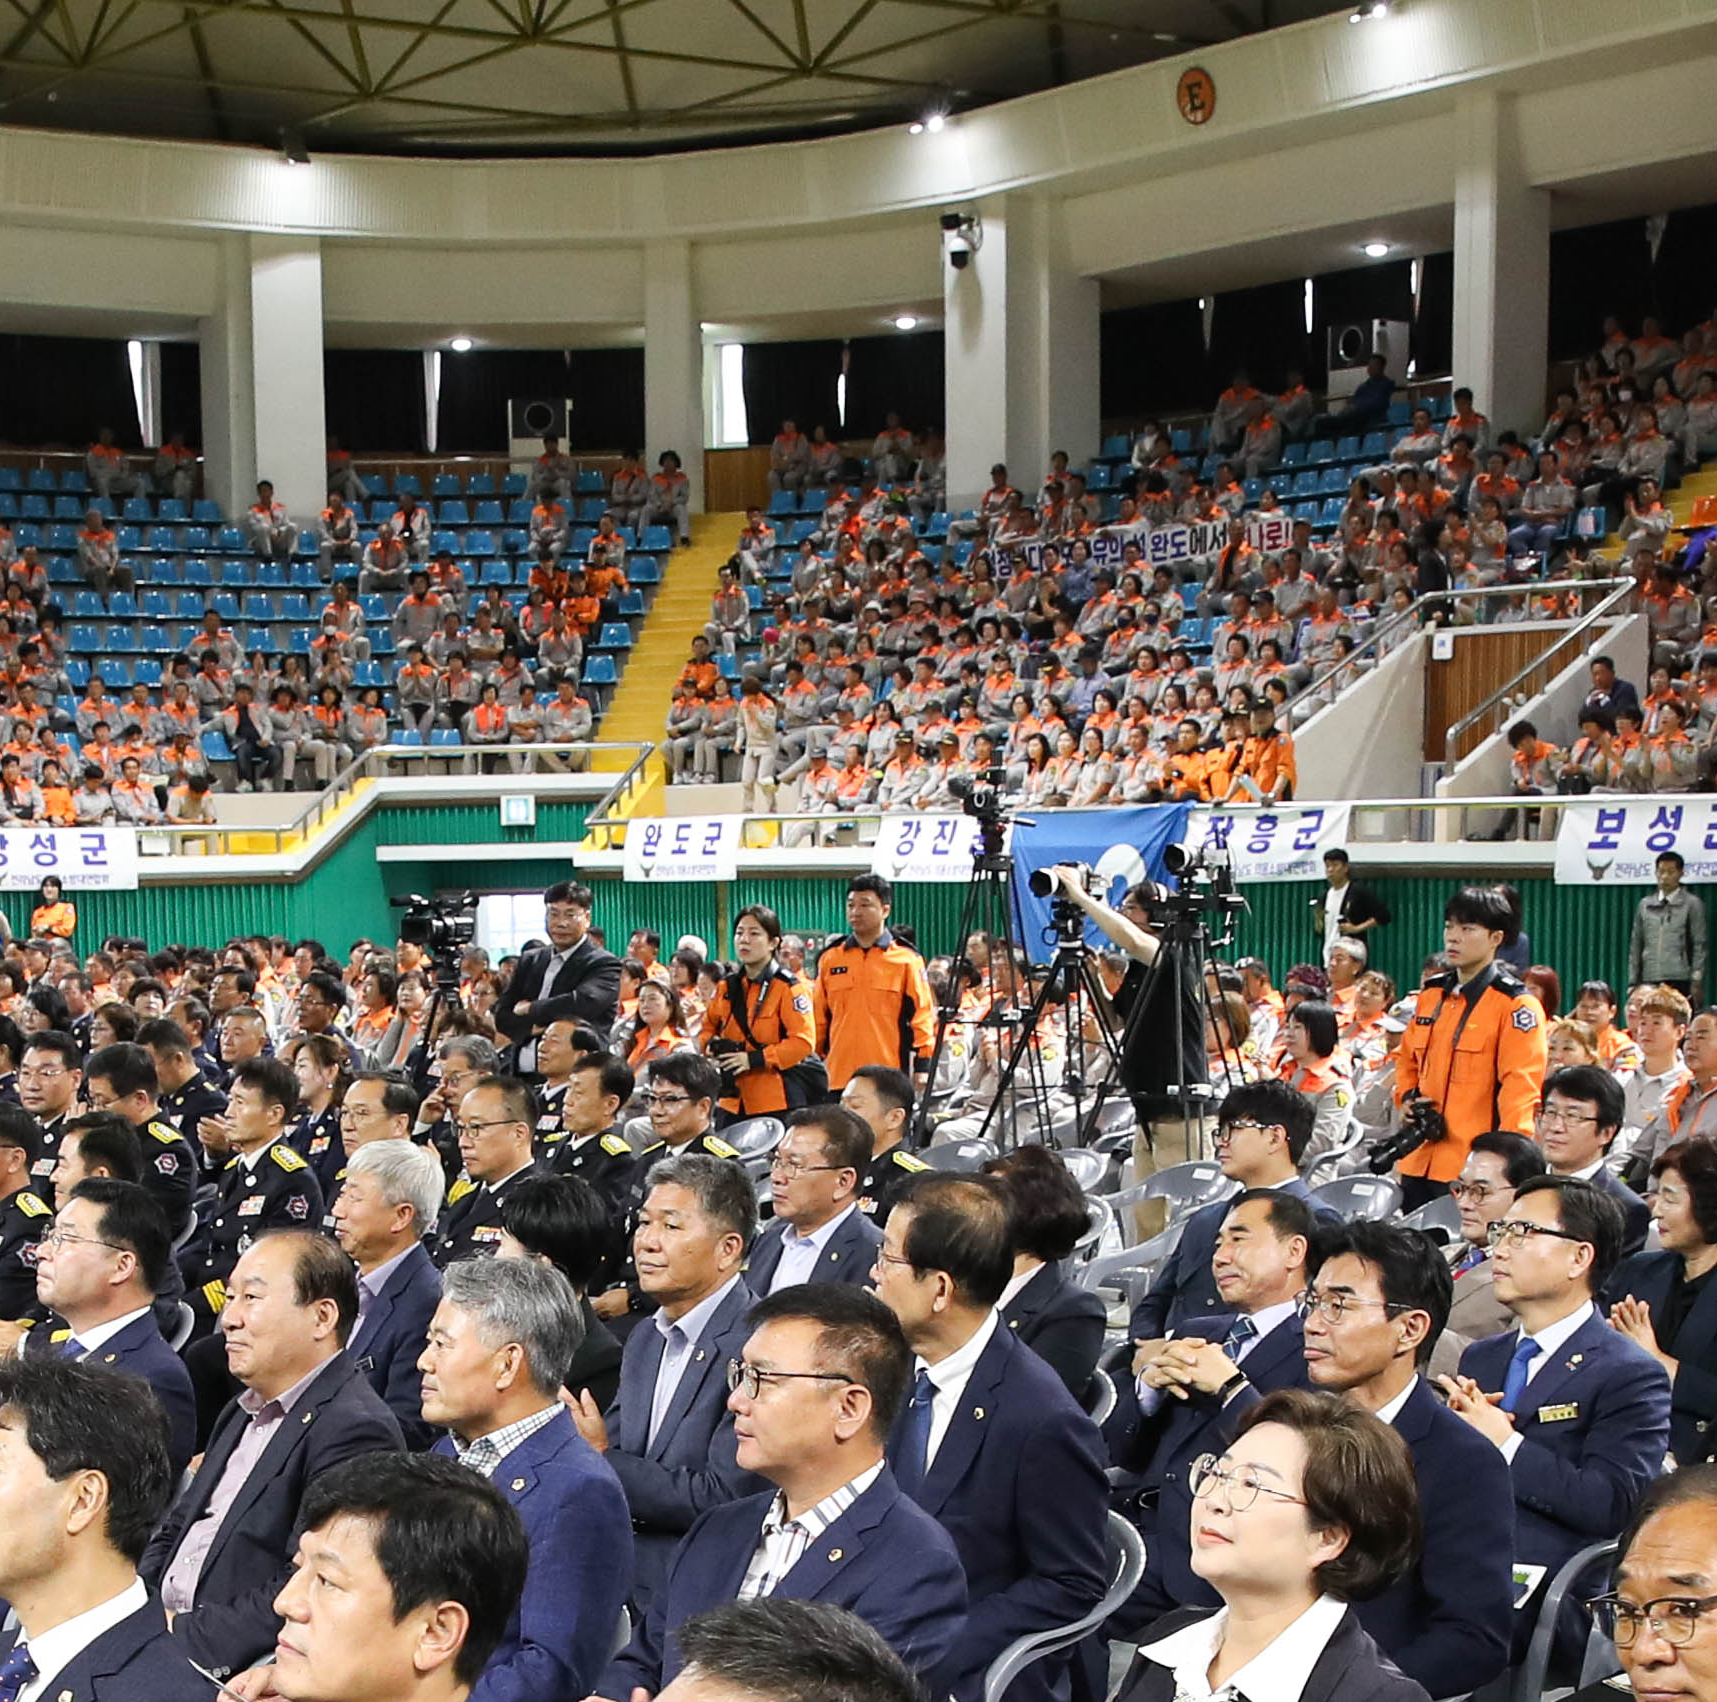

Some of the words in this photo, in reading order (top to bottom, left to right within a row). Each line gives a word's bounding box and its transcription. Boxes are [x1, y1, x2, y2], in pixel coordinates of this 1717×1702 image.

[1186, 82, 1206, 111] E
[1151, 525, 1227, 562] 완도에서
[643, 822, 723, 857] 완도군
[1202, 810, 1324, 854] 장흥군
